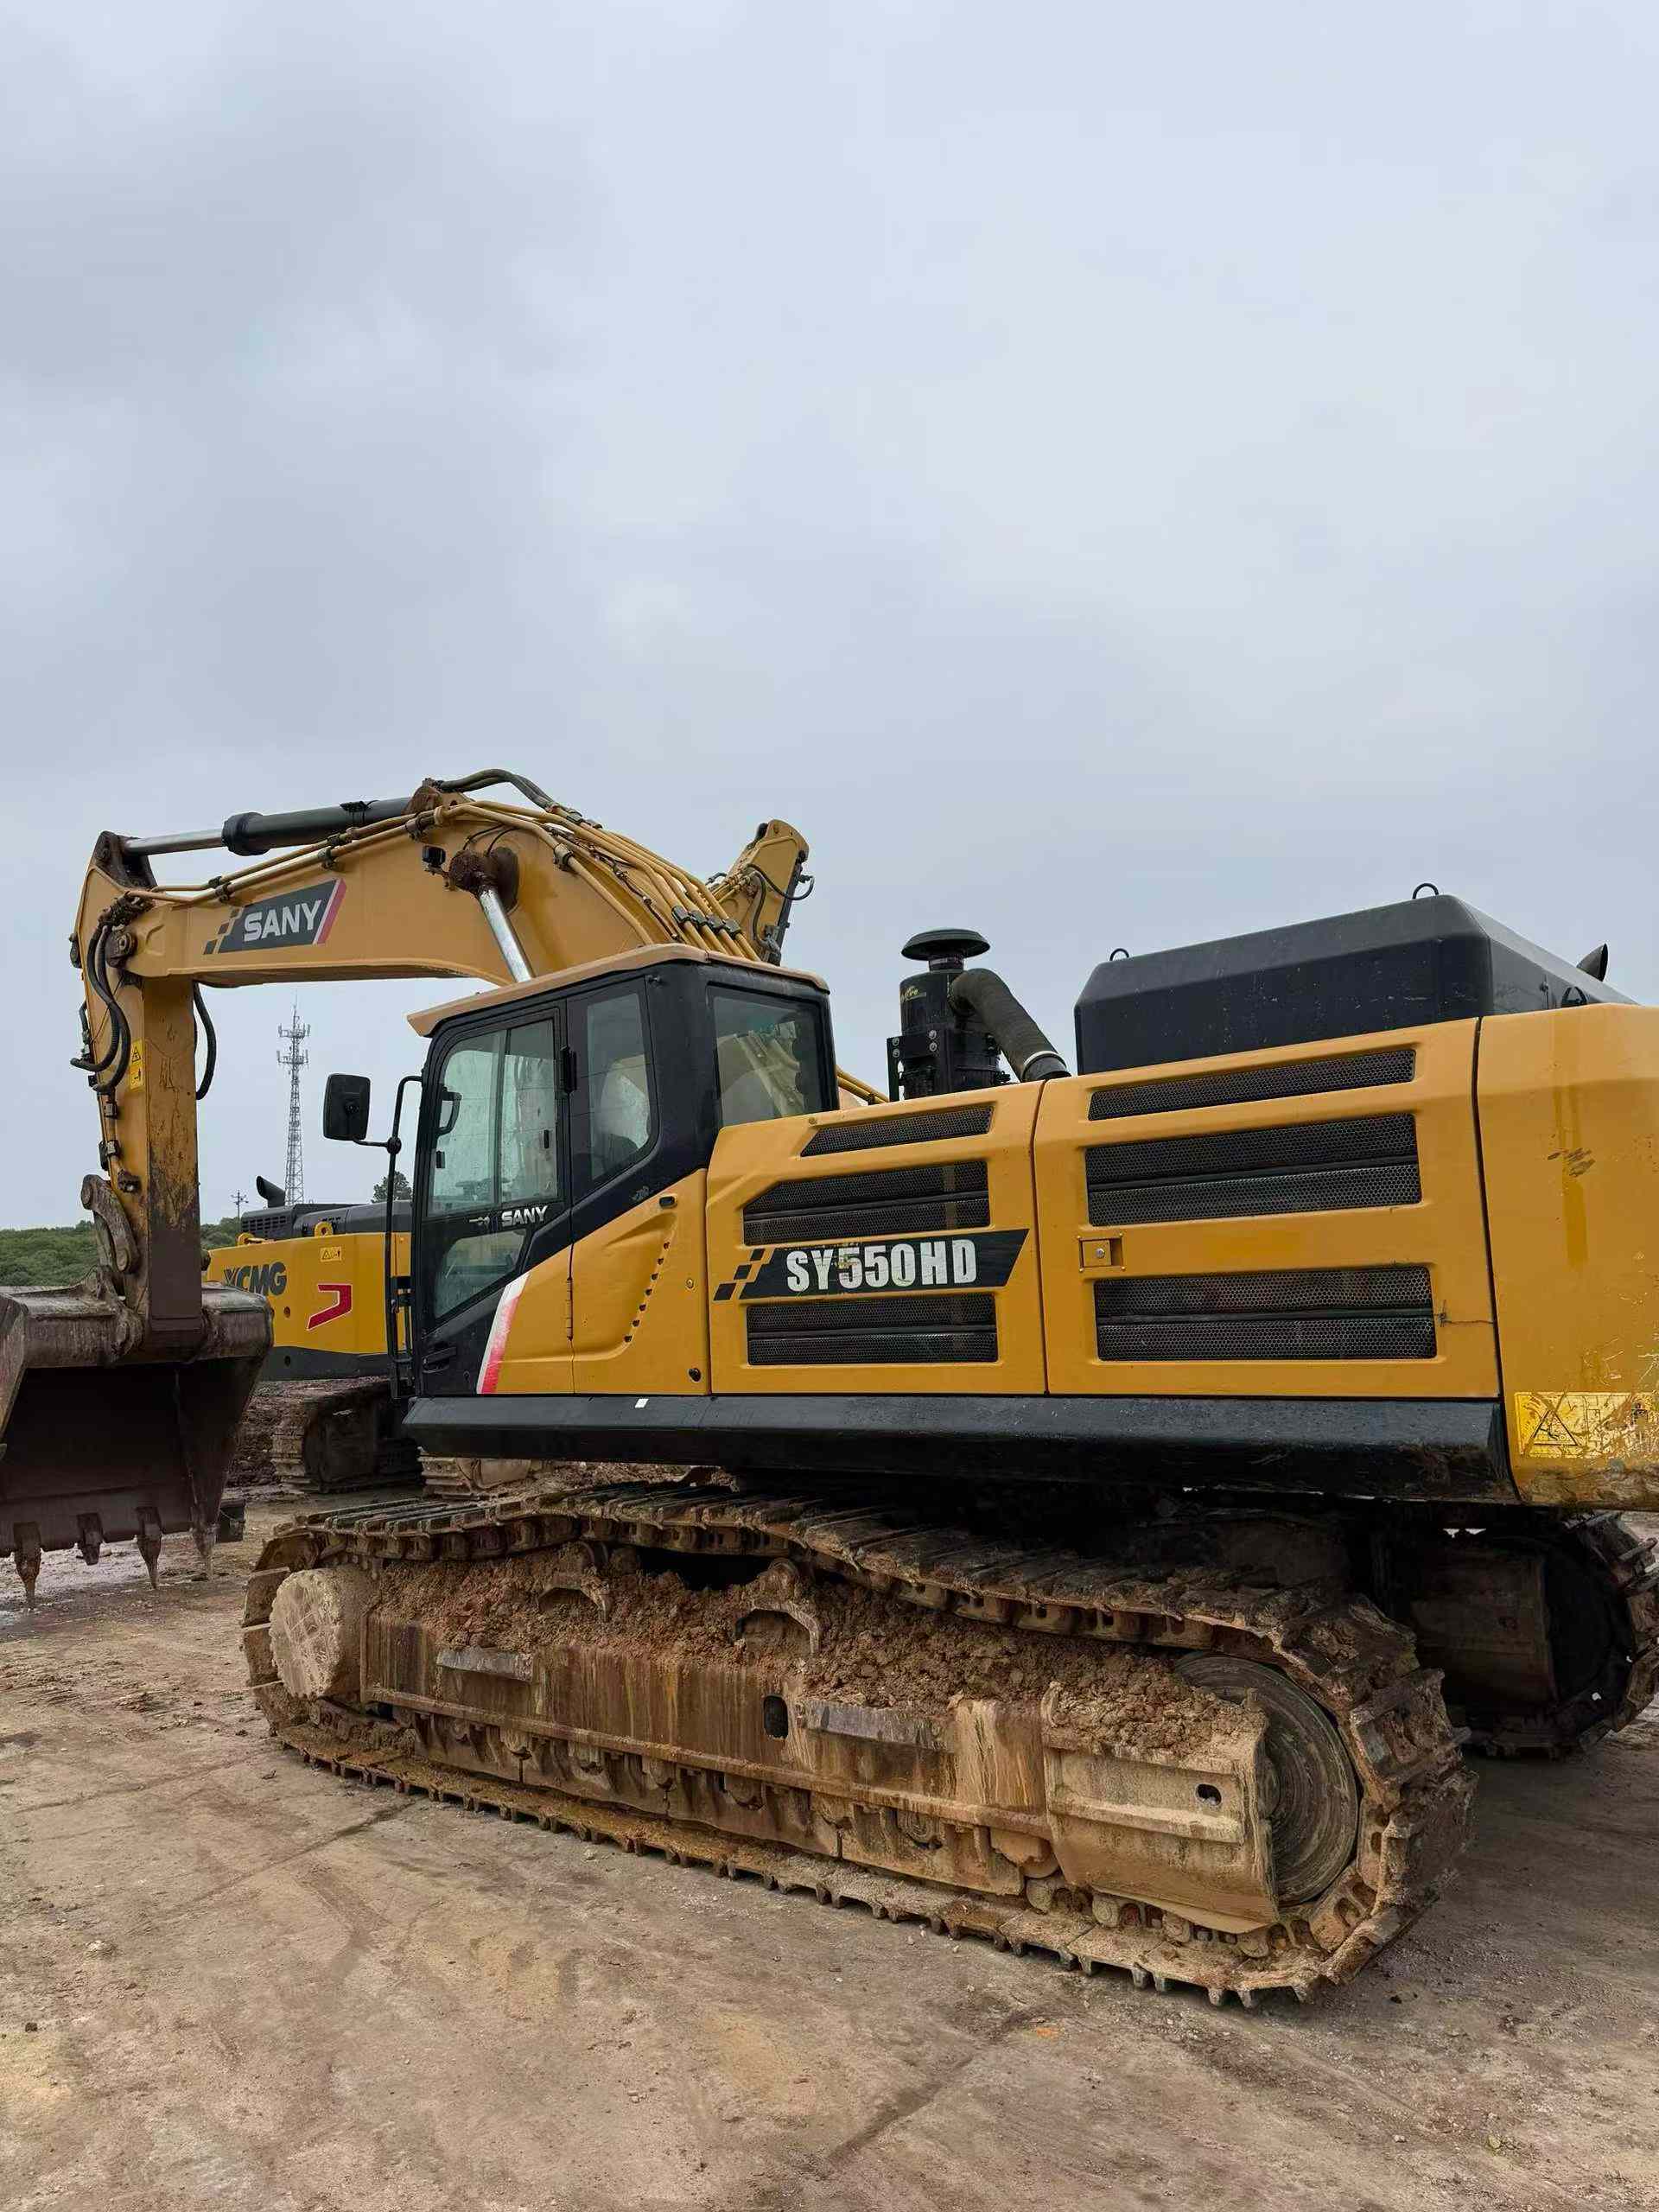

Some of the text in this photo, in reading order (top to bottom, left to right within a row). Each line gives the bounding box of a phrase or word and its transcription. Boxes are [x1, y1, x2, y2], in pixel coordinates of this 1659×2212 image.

[244, 899, 322, 942] SANY
[501, 1205, 548, 1227] SANY
[786, 1239, 977, 1292] SY550HD
